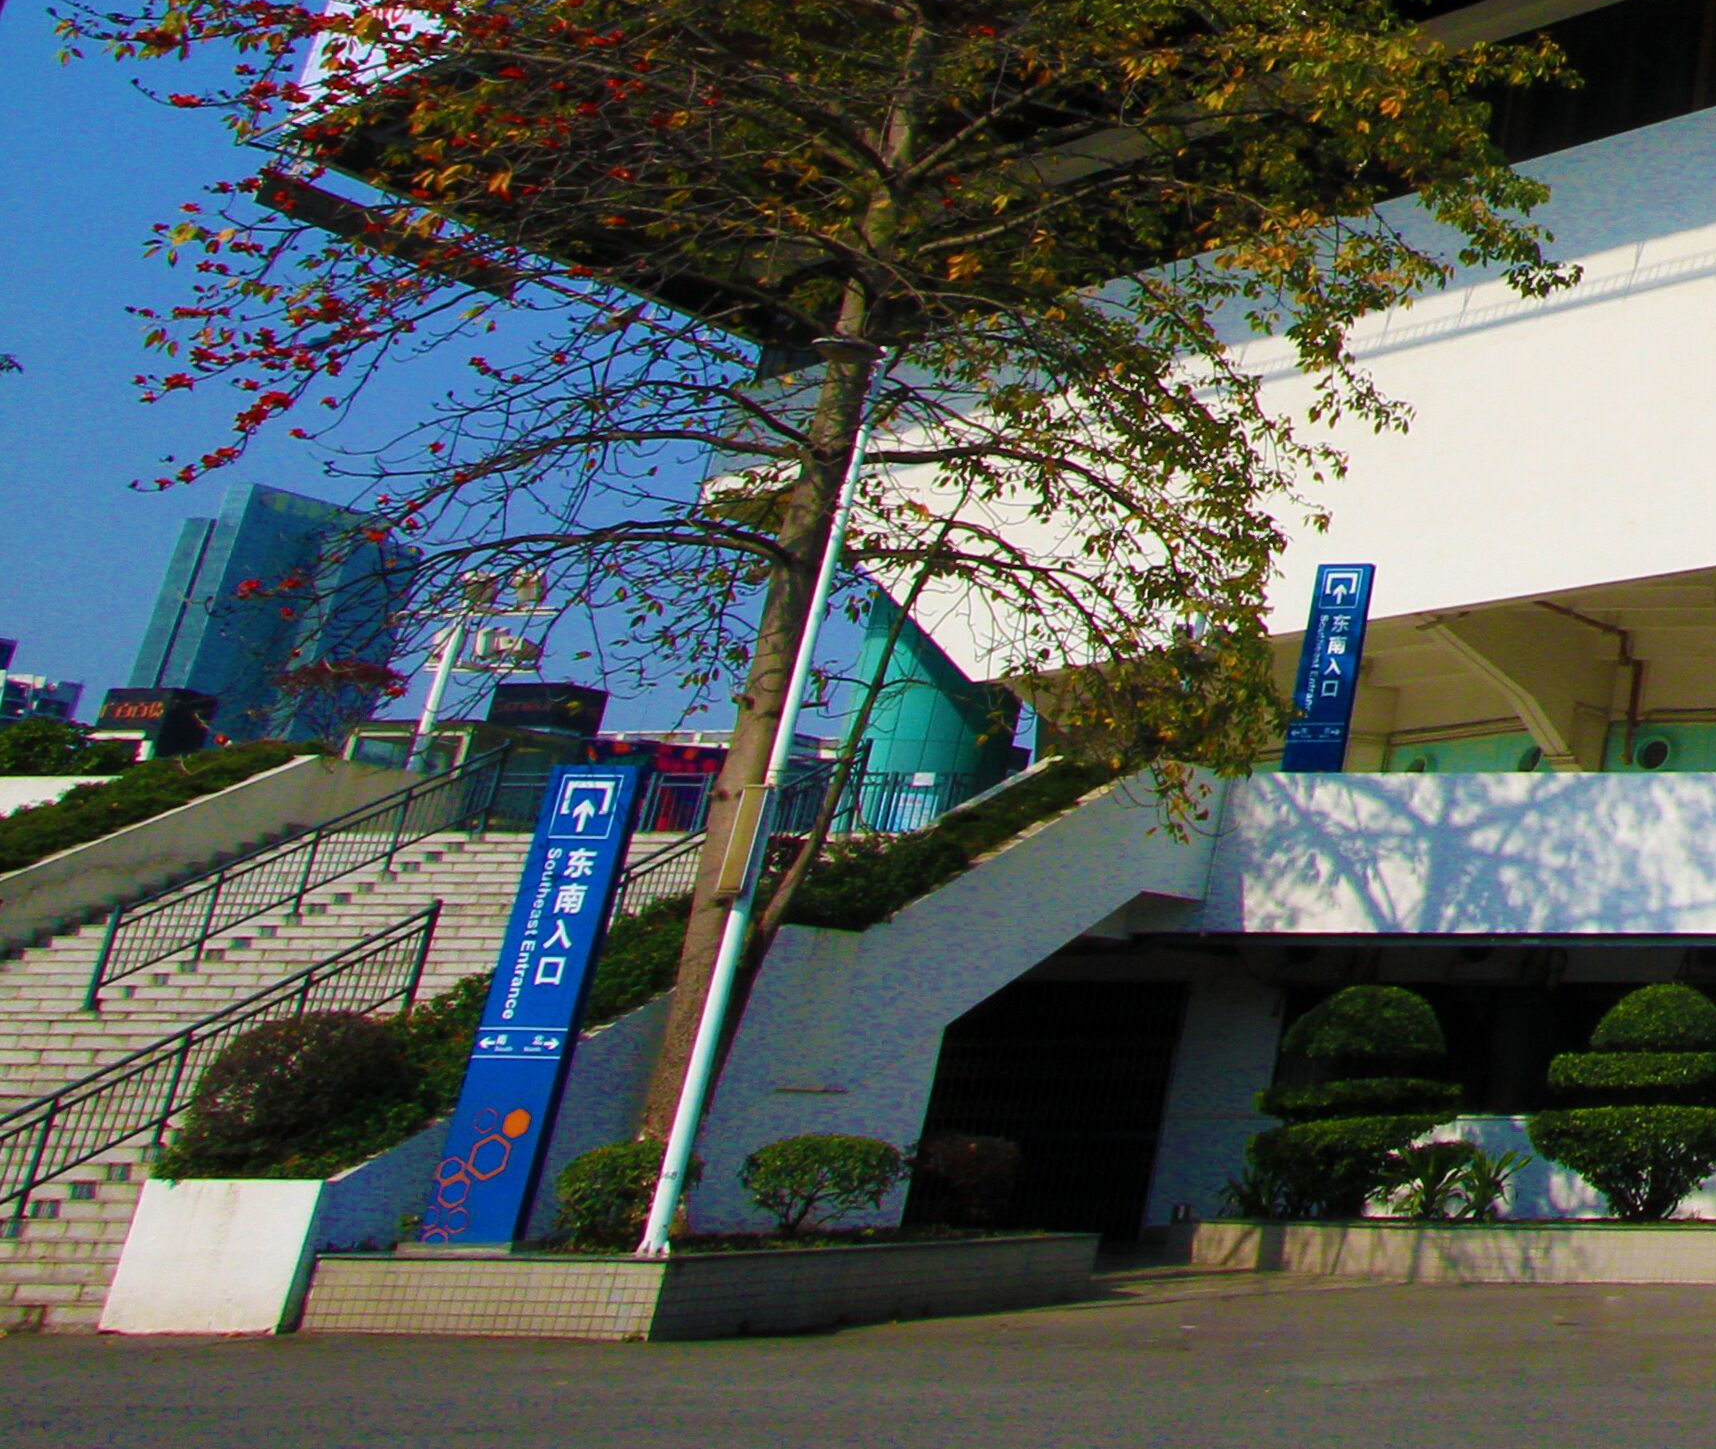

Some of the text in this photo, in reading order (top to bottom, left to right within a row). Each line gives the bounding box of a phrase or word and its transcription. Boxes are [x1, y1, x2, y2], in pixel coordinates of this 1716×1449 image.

[1321, 614, 1352, 698] 东南入口
[501, 847, 563, 1021] Southeast Entrance
[533, 847, 597, 986] 东南入口
